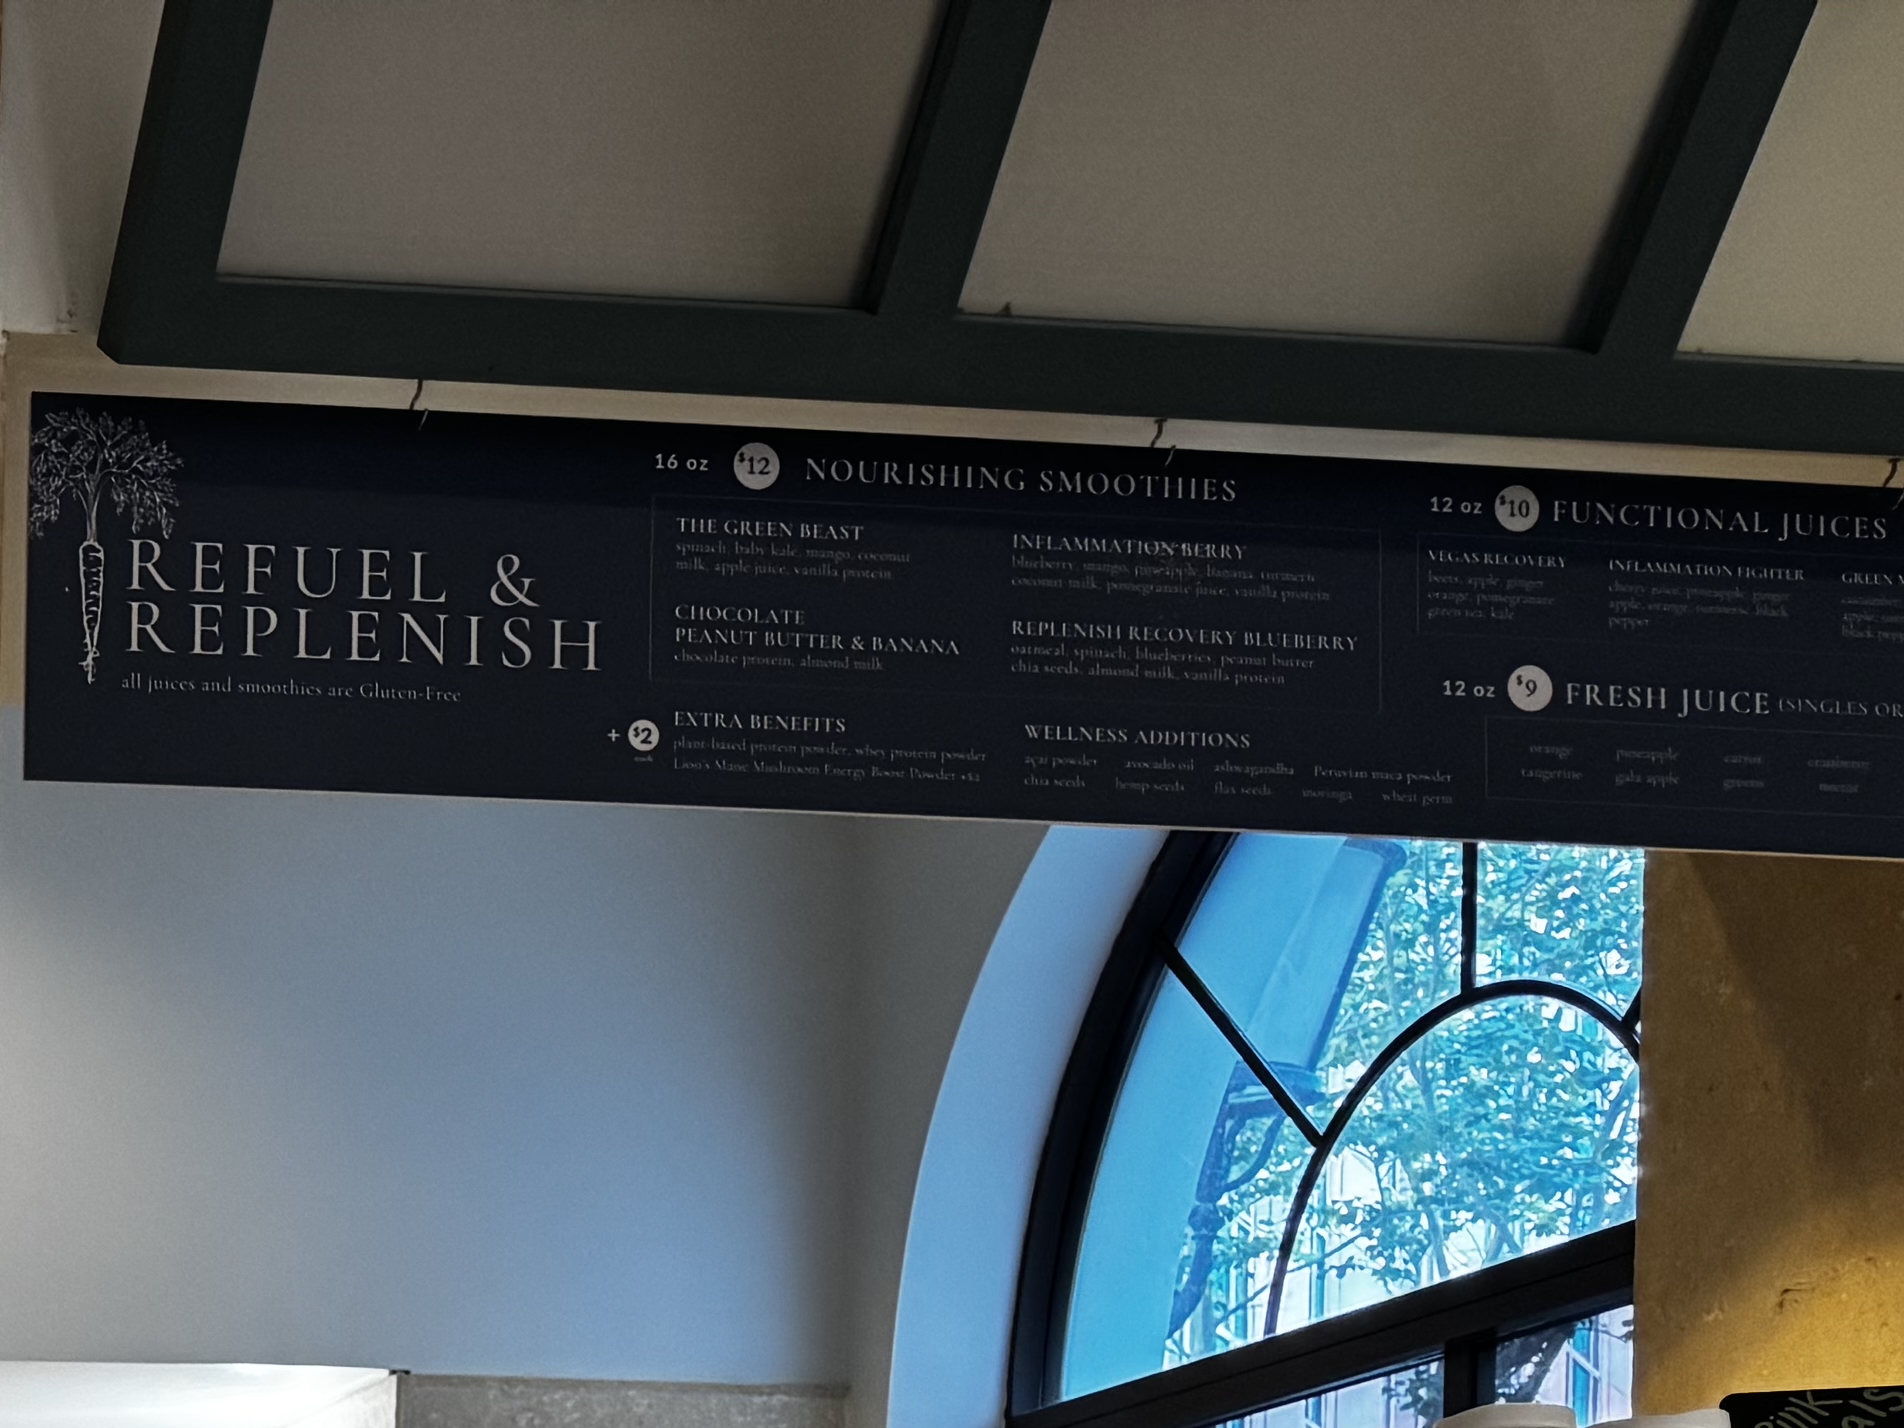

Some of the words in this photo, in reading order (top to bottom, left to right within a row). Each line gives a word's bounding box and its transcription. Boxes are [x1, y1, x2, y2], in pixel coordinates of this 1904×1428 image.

[656, 453, 677, 468] 16
[686, 459, 708, 470] oz
[738, 452, 770, 474] $12
[806, 458, 1024, 490] NOURISHING
[1040, 470, 1235, 501] SMOOTHIES
[676, 518, 717, 534] THE
[724, 519, 792, 537] GREEN
[800, 523, 863, 540] BEAST
[1430, 496, 1452, 512] 12
[1460, 502, 1481, 513] oz
[1499, 494, 1530, 518] $10
[1554, 500, 1768, 532] FUNCTIONAL
[1778, 513, 1885, 541] JUICES
[1182, 542, 1247, 560] BERRY
[1428, 550, 1480, 564] VEGAS
[1483, 552, 1565, 568] RECOVERY
[128, 538, 446, 602] REFUEL
[490, 554, 538, 606] &
[675, 605, 805, 625] CHOCOLATE
[127, 601, 598, 670] REPLENISH
[676, 627, 756, 645] PEANUT
[765, 631, 843, 649] BUTTER
[851, 636, 863, 650] &
[872, 636, 958, 654] BANANA
[1012, 620, 1120, 639] REPLENISH
[1129, 626, 1235, 644] RECOVERY
[1244, 632, 1356, 650] BLUEBERRY
[122, 672, 140, 688] all
[148, 676, 194, 693] juices
[202, 676, 230, 691] and
[238, 679, 321, 694] smoothies
[328, 687, 352, 697] are
[360, 681, 460, 701] Gluten-Free
[1443, 680, 1465, 695] 12
[1473, 685, 1494, 697] oz
[1517, 675, 1537, 697] $9
[1567, 683, 1665, 708] FRESH
[1678, 689, 1769, 717] JUICE
[634, 726, 652, 744] $2
[675, 711, 742, 728] EXTRA
[751, 714, 845, 732] BENEFITS
[1025, 724, 1127, 741] WELLNESS
[1135, 730, 1249, 747] ADDITIONS
